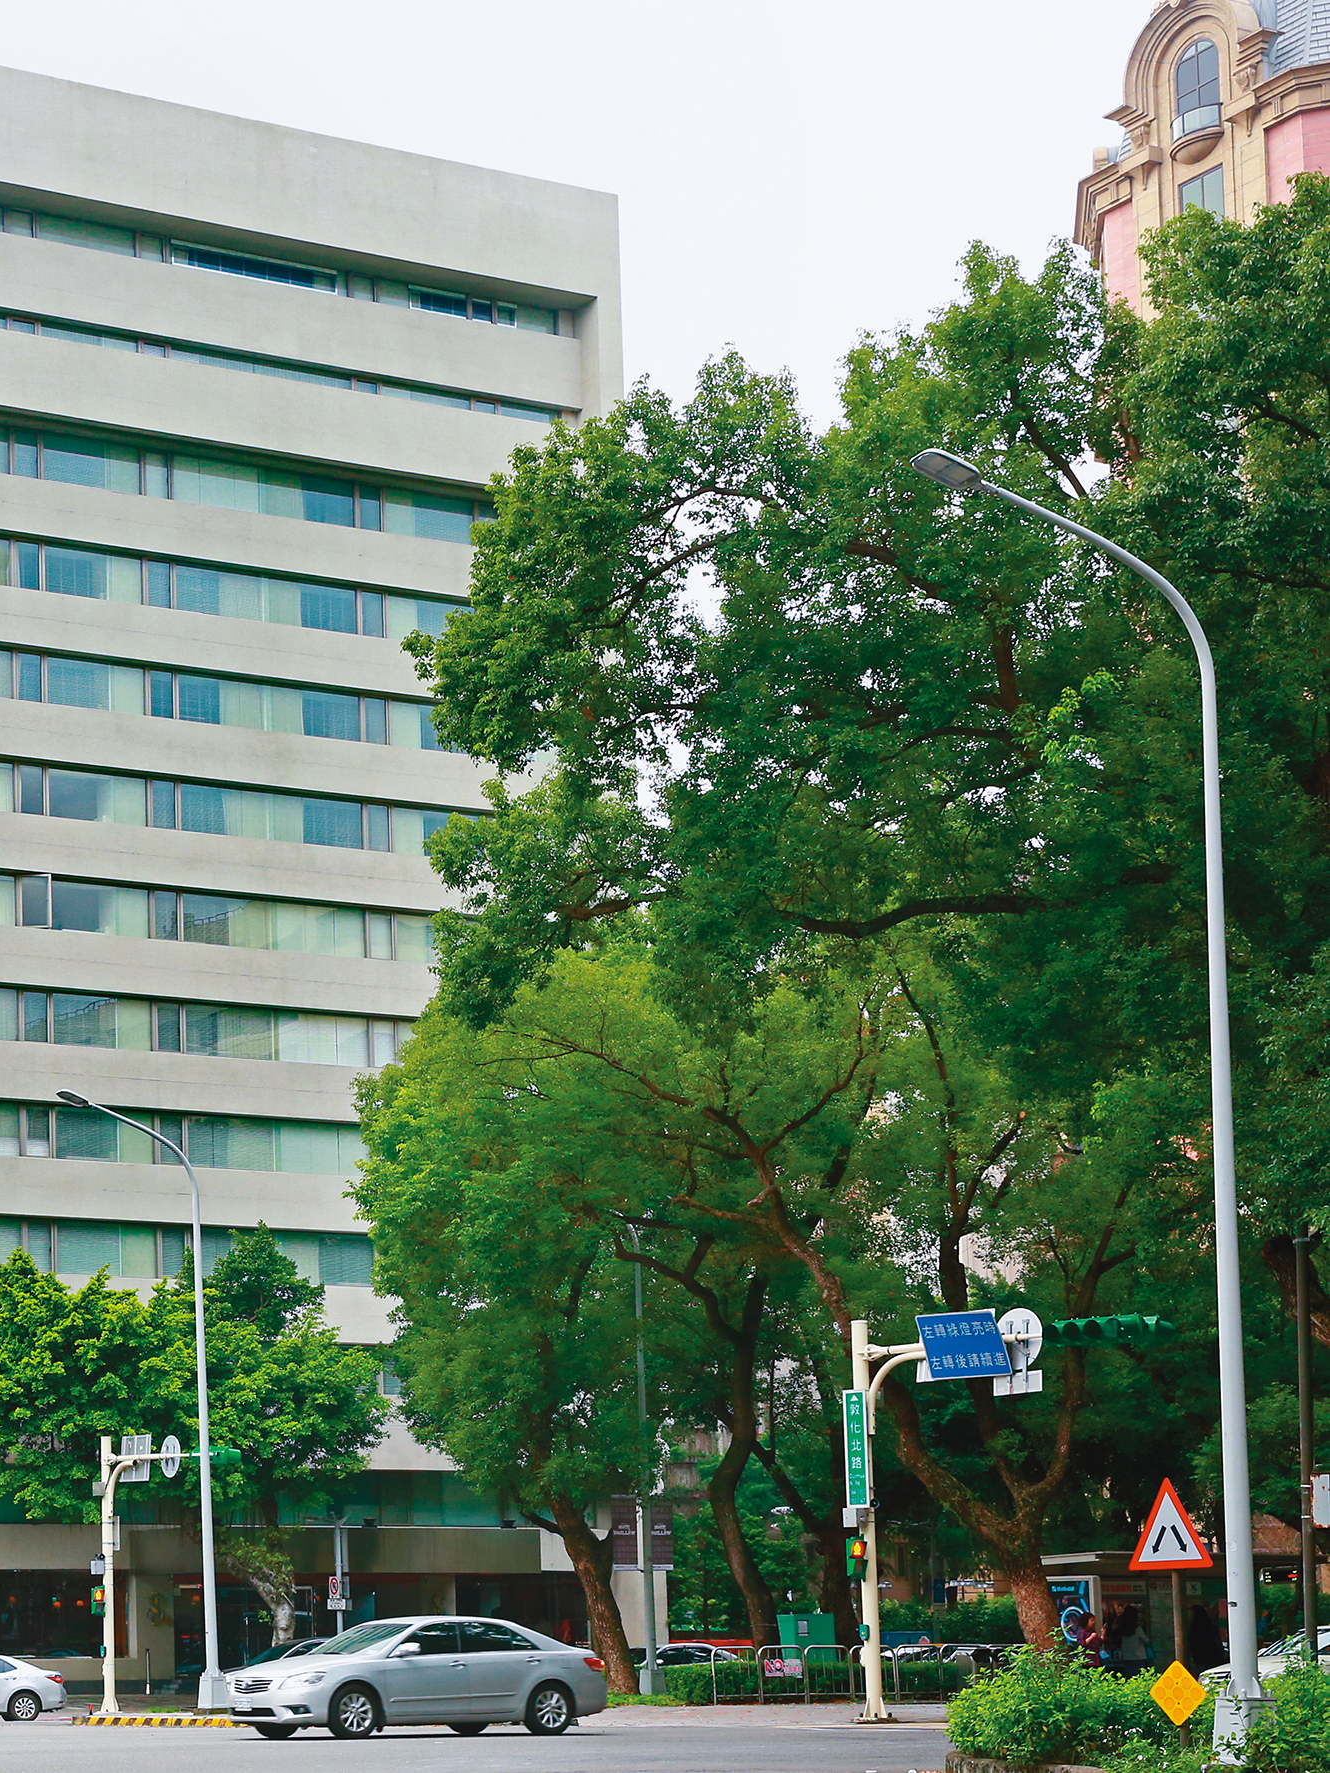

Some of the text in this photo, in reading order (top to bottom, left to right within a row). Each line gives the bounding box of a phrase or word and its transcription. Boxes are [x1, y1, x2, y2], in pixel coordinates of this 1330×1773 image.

[922, 1321, 996, 1339] 左轉綠燈亮時
[930, 1352, 1007, 1370] 左轉後請續進
[849, 1403, 862, 1469] 敦化北路
